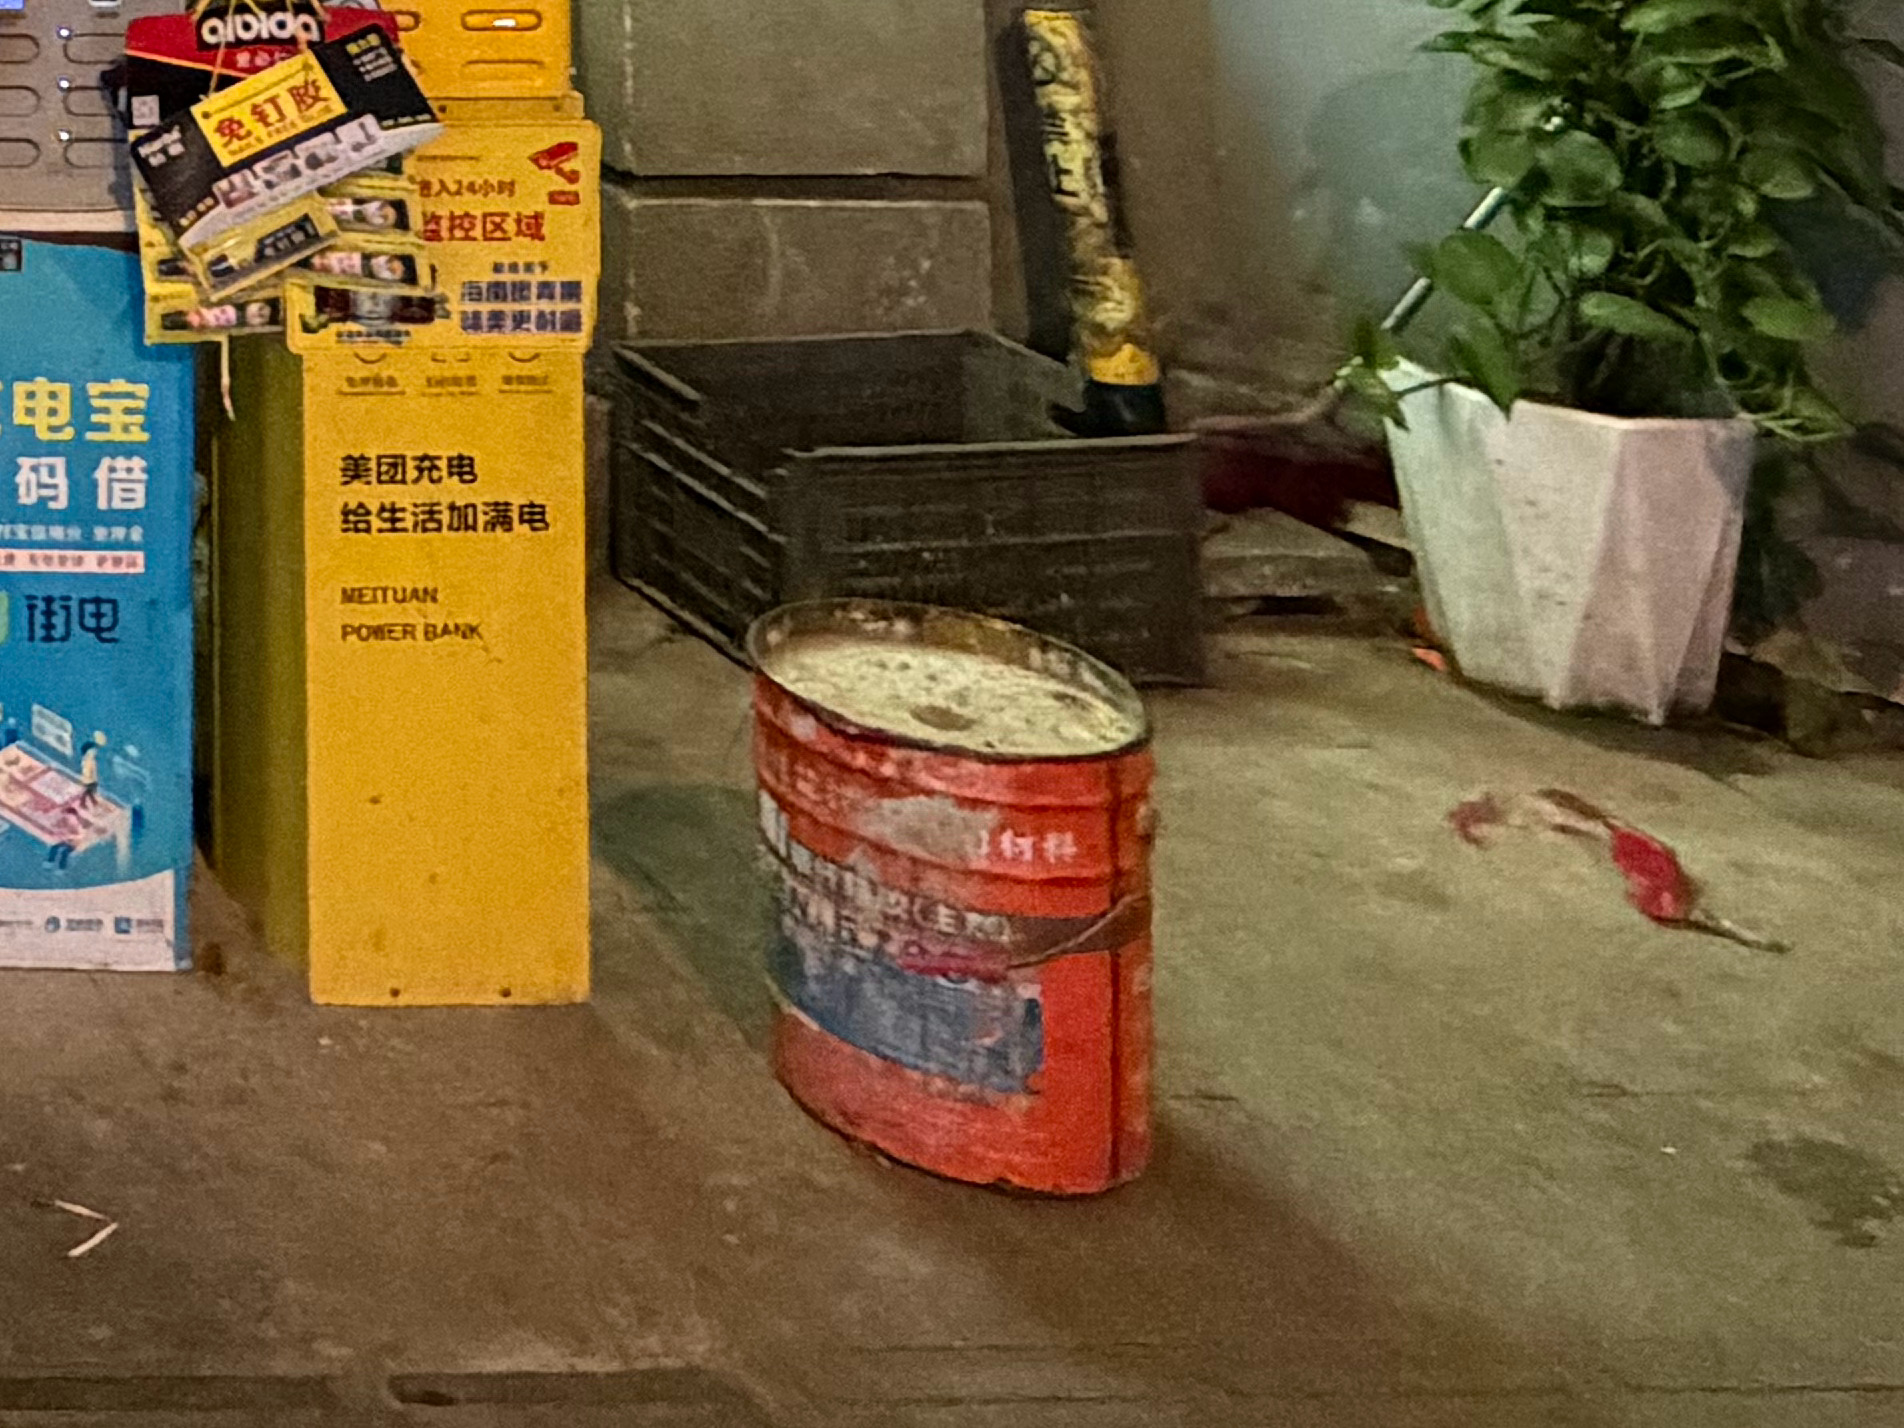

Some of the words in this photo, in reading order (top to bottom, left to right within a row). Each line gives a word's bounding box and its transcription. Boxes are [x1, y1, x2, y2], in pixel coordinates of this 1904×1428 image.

[213, 78, 331, 148] 免钉胶
[422, 210, 546, 242] 监控区域
[339, 453, 479, 486] 美团充电
[340, 500, 550, 535] 给生活加满电
[340, 585, 439, 604] MEITUAN
[24, 593, 120, 644] 街电
[340, 621, 418, 642] POWER
[423, 621, 483, 642] BANK
